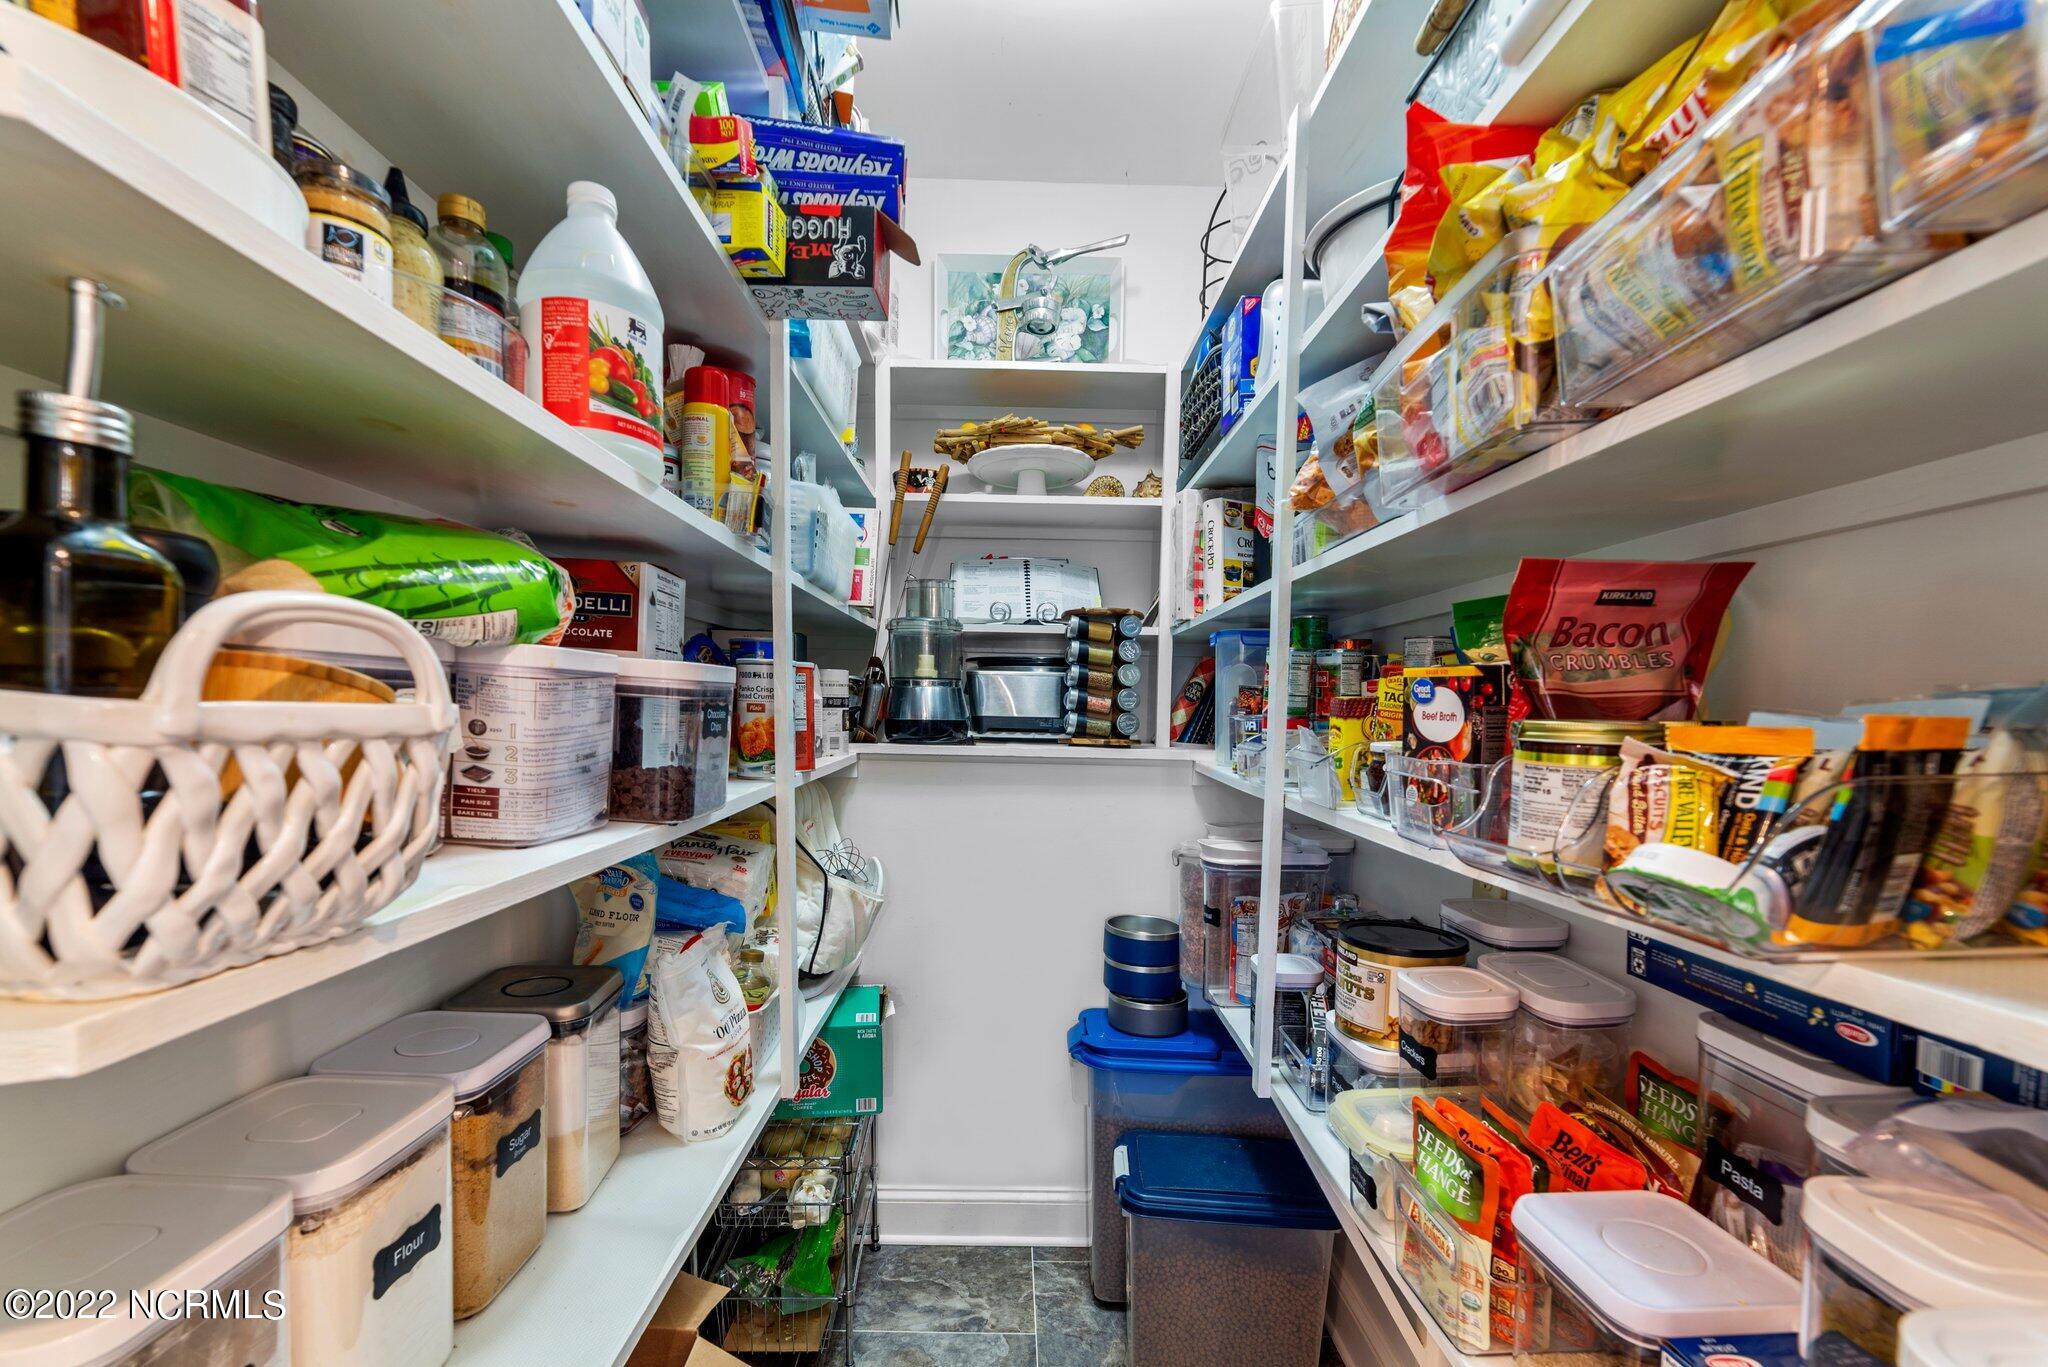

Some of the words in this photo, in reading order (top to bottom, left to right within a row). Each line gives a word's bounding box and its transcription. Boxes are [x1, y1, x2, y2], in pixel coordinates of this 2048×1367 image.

[719, 118, 735, 130] 100
[780, 136, 795, 144] 1947
[795, 138, 815, 149] SINCE
[815, 141, 843, 153] TRUSTED
[754, 144, 796, 172] Wra
[796, 153, 893, 177] Reynolds
[808, 180, 835, 191] TRUSTED
[787, 216, 852, 240] HUGG
[684, 415, 709, 423] ORIGINAL
[630, 564, 638, 572] 6
[1601, 590, 1653, 600] KIRKLAND
[565, 627, 613, 638] OCOLATE
[1550, 616, 1671, 649] Bacon
[1550, 651, 1675, 671] CRUMBLES
[755, 685, 774, 695] Crisp
[1413, 683, 1432, 693] Great
[1384, 691, 1404, 703] TAC
[707, 708, 727, 720] Chocolate
[1380, 710, 1404, 719] ORIGIN
[1421, 710, 1439, 721] Beef
[1439, 711, 1458, 722] Broth
[510, 723, 517, 739] 1
[710, 721, 722, 733] Chips
[504, 745, 519, 763] 2
[504, 768, 519, 785] 3
[1672, 801, 1696, 847] VALLE
[663, 849, 715, 860] EVERYDAY
[670, 840, 723, 856] Vanity
[722, 844, 760, 857] Fair
[608, 911, 640, 922] FLOUR
[729, 1007, 748, 1028] Pizza
[806, 1049, 824, 1073] SHOP
[1401, 1040, 1426, 1066] Crackers
[800, 1073, 818, 1084] FFEE
[793, 1084, 831, 1103] gular
[1638, 1074, 1698, 1122] SEEDS
[1640, 1096, 1698, 1144] HANG
[509, 1125, 532, 1152] Sugar
[1585, 1101, 1620, 1124] HOMEMADE
[1619, 1114, 1637, 1133] TASTE
[1643, 1133, 1681, 1171] MINUTES
[1417, 1123, 1464, 1176] SEEDS
[1551, 1129, 1603, 1176] Ben's
[1720, 1158, 1764, 1200] Pasta
[393, 1231, 426, 1267] Flour
[1495, 1264, 1510, 1277] 90
